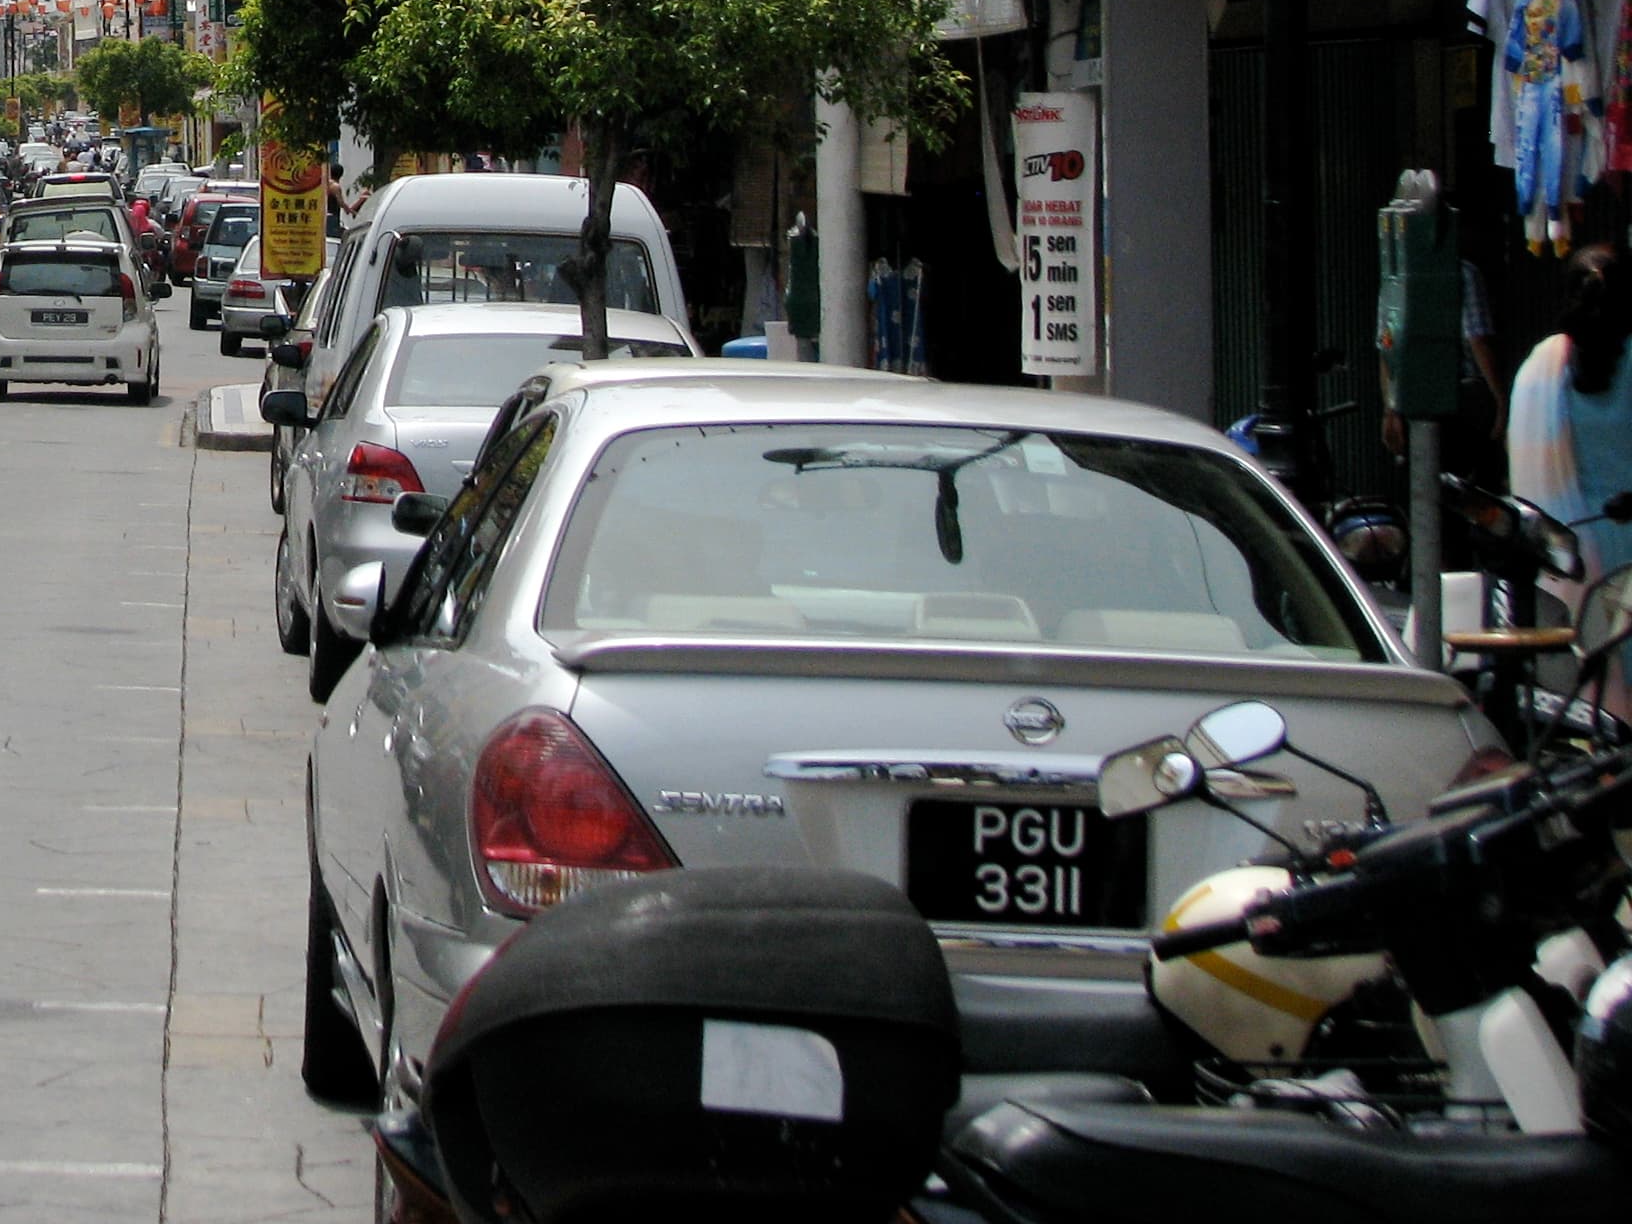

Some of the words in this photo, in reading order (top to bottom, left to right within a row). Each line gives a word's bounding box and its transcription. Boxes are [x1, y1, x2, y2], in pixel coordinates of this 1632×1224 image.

[1045, 200, 1082, 212] HEBAT
[1047, 235, 1076, 253] sen
[1047, 264, 1077, 283] min
[1031, 295, 1041, 340] 1
[1047, 295, 1076, 313] sen
[1047, 323, 1077, 342] SMS
[654, 791, 784, 815] SENTRA
[974, 808, 1085, 856] PGU
[975, 864, 1080, 914] 3311
